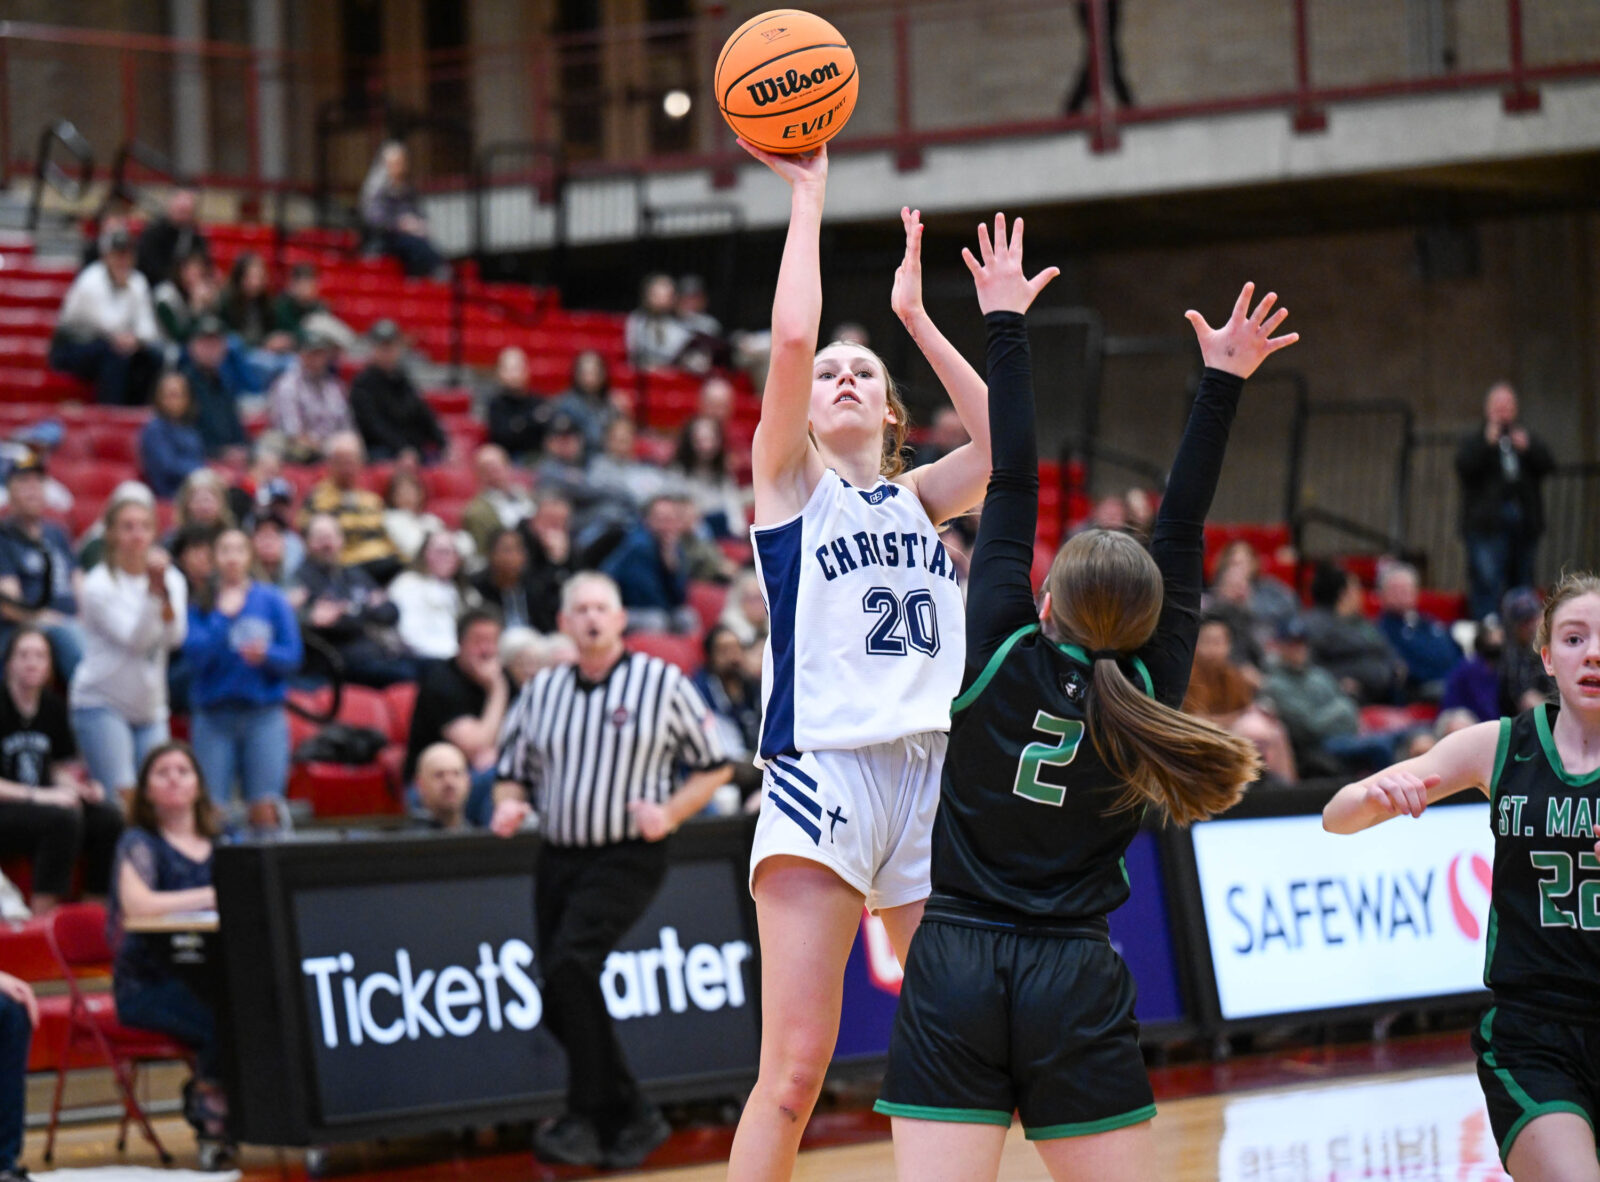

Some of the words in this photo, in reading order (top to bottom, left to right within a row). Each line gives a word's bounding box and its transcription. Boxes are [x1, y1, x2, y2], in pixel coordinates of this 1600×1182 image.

[746, 62, 841, 107] Wilson
[782, 109, 834, 139] EVO
[862, 586, 941, 658] 20
[1012, 709, 1086, 807] 2
[1498, 795, 1534, 837] ST.
[1545, 796, 1600, 838] MA
[1226, 868, 1437, 955] SAFEWAY
[301, 926, 752, 1048] TicketSarter
